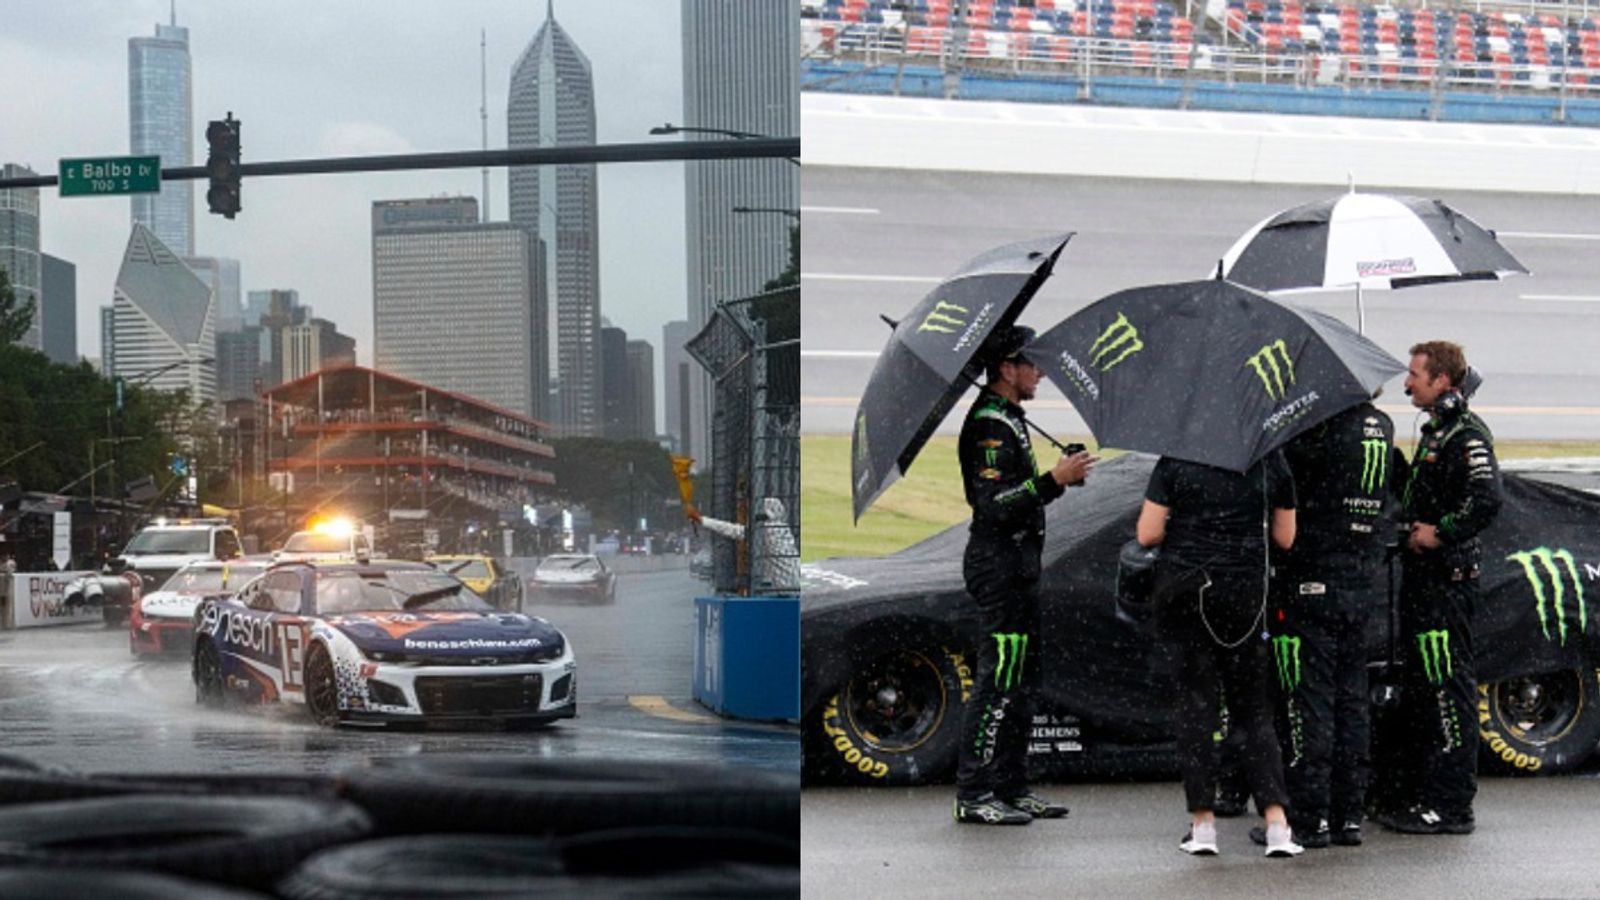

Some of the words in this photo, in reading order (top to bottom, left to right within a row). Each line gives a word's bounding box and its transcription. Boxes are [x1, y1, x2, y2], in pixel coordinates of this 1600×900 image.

[83, 162, 132, 178] Balbo
[91, 180, 116, 191] 700
[1263, 391, 1319, 431] MONSTER
[196, 600, 274, 656] enesch
[278, 624, 304, 686] 13
[404, 638, 541, 650] beneschlaw.com
[1032, 727, 1080, 738] IEMENS
